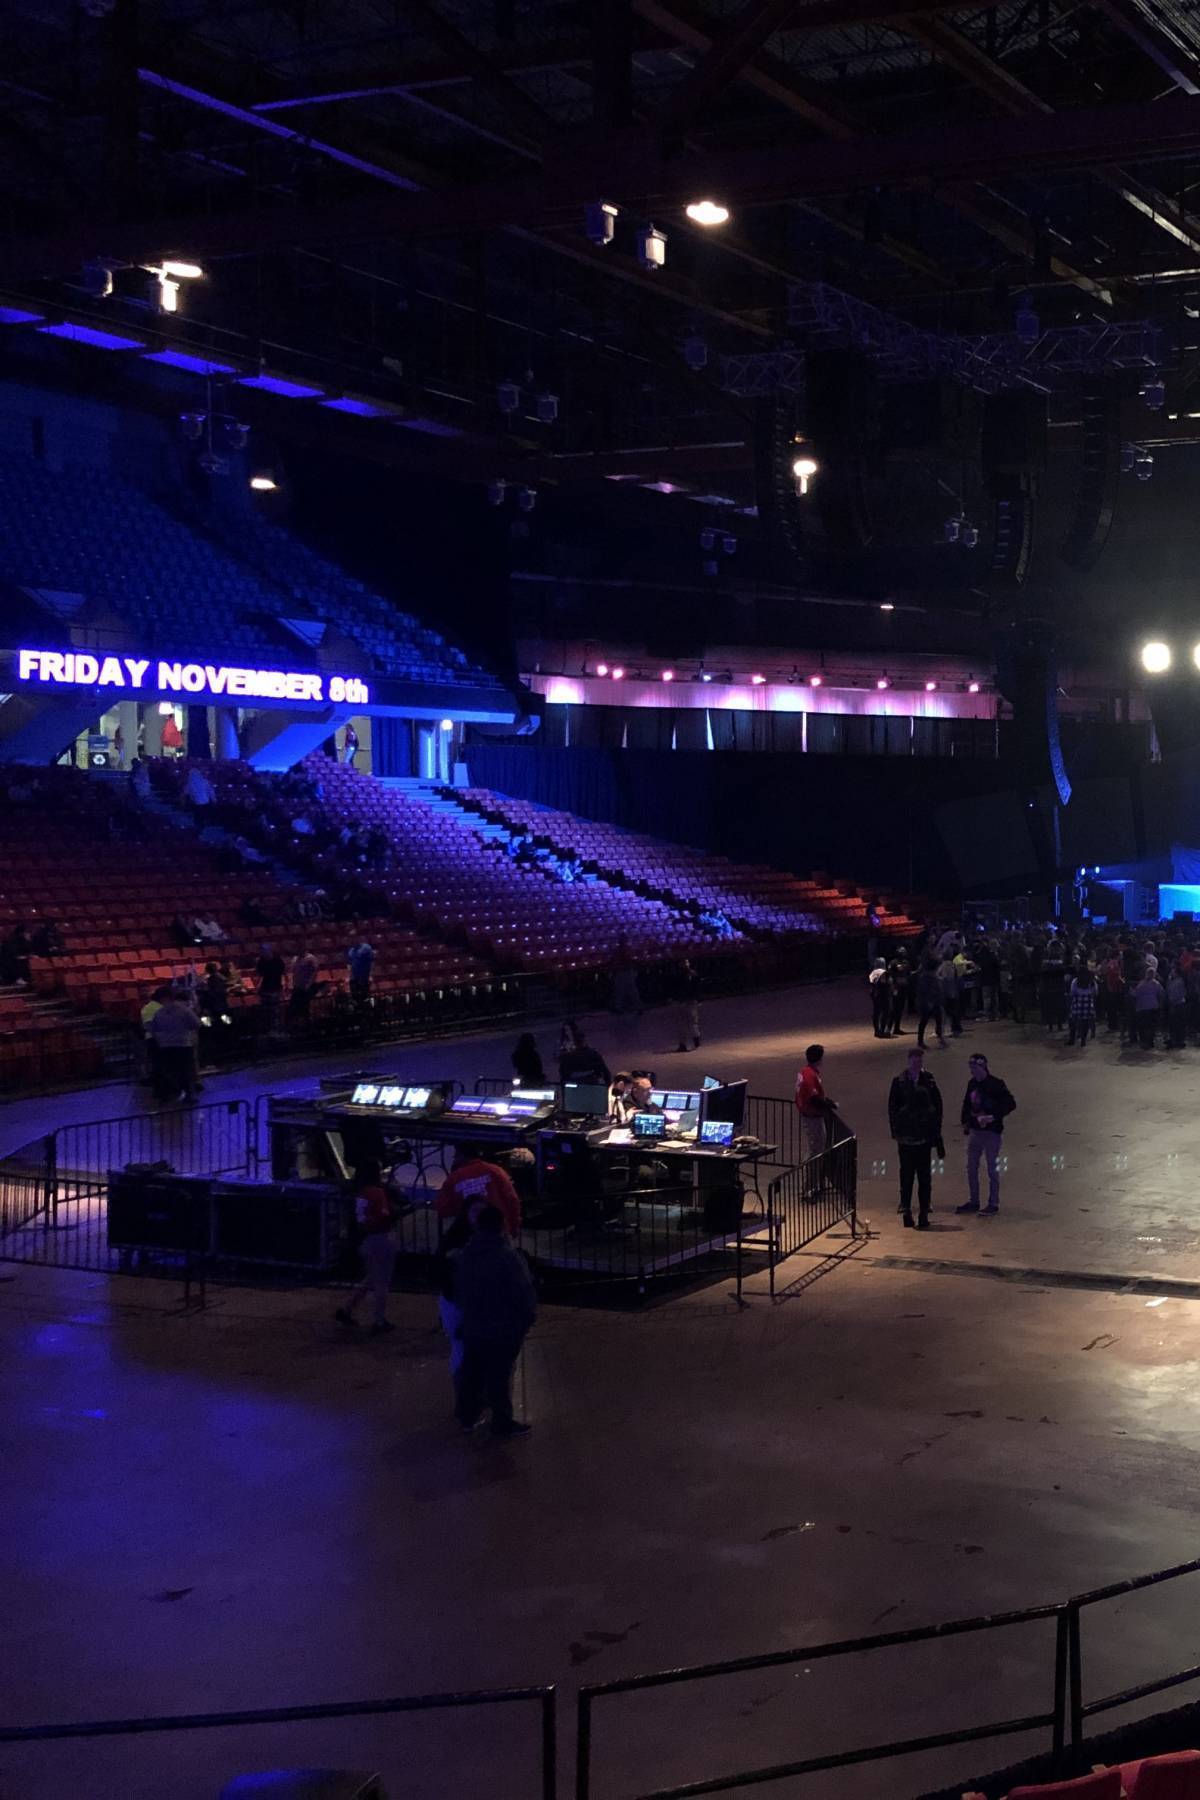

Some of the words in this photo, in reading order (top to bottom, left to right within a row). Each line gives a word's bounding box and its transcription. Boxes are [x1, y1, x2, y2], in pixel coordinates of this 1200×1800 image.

[19, 649, 150, 688] FRIDAY
[158, 662, 323, 701] NOVEMBER
[329, 677, 368, 704] 8th
